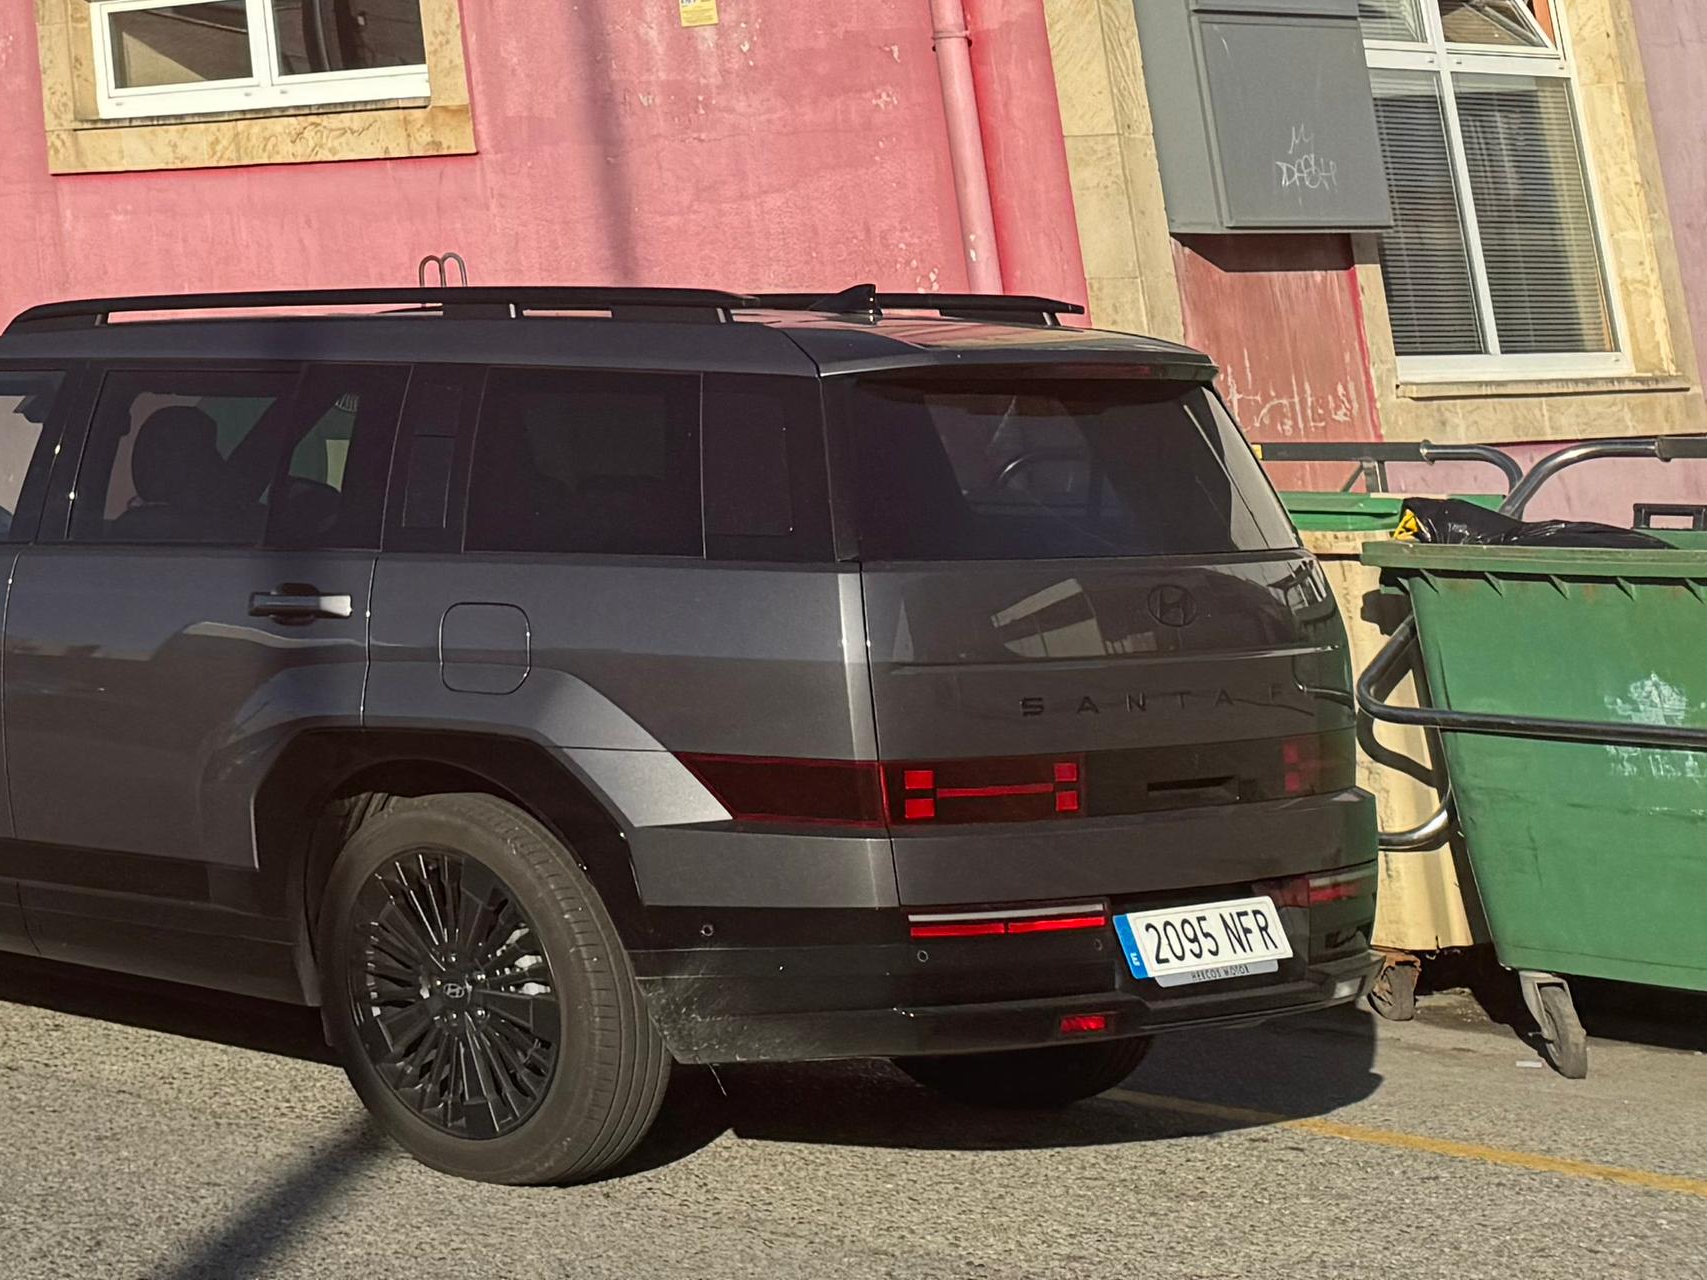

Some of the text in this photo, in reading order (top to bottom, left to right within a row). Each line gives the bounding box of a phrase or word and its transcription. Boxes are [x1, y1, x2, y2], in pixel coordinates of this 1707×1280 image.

[1019, 691, 1235, 717] SANTA
[1145, 909, 1279, 965] 2095 NFR
